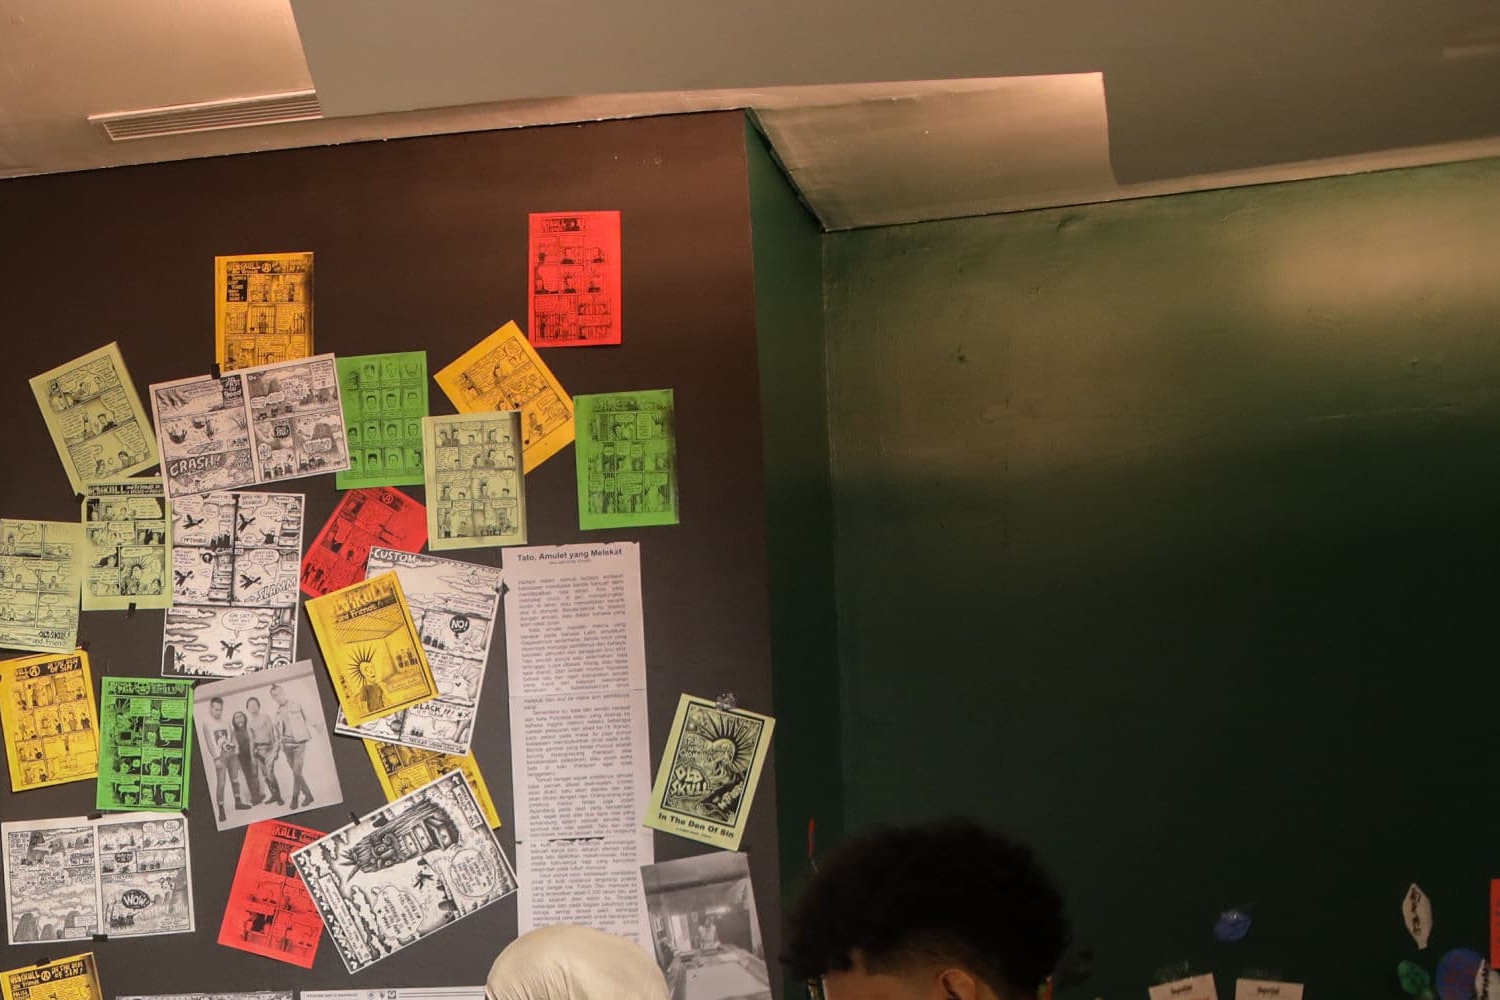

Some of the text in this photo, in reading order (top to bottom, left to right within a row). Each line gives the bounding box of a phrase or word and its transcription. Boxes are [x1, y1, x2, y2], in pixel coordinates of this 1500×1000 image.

[169, 455, 221, 477] CRASH!
[539, 552, 567, 560] Amulet
[569, 550, 589, 559] yang
[590, 548, 622, 557] Melekat
[674, 766, 704, 784] OLD
[671, 779, 711, 797] SKULL
[658, 812, 734, 838] In The Den Of Sin
